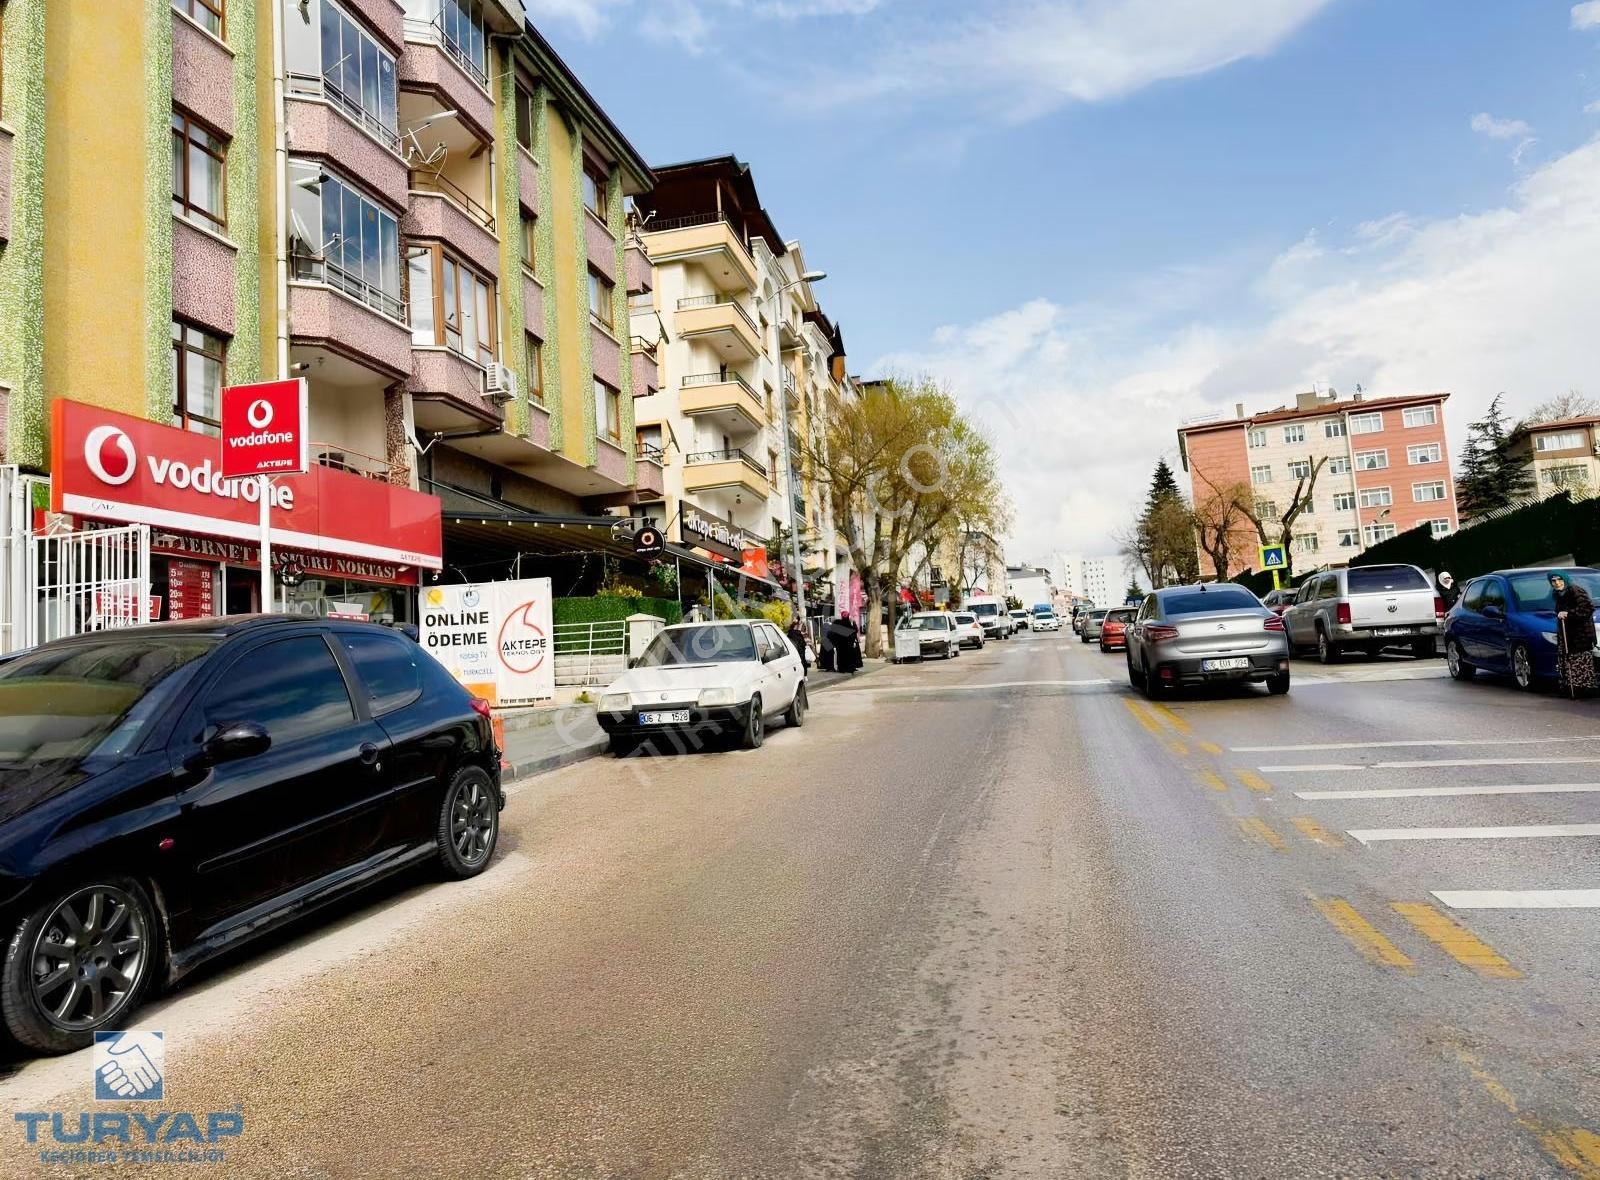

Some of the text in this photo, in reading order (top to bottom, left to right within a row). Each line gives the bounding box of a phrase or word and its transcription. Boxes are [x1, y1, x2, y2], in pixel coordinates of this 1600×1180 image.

[229, 431, 293, 448] vodafone
[256, 459, 293, 469] AKTEPE
[336, 558, 397, 580] NOKTASI
[425, 610, 489, 627] ONLİNE
[427, 631, 488, 647] ÖDEME
[502, 638, 547, 651] AKTEPE
